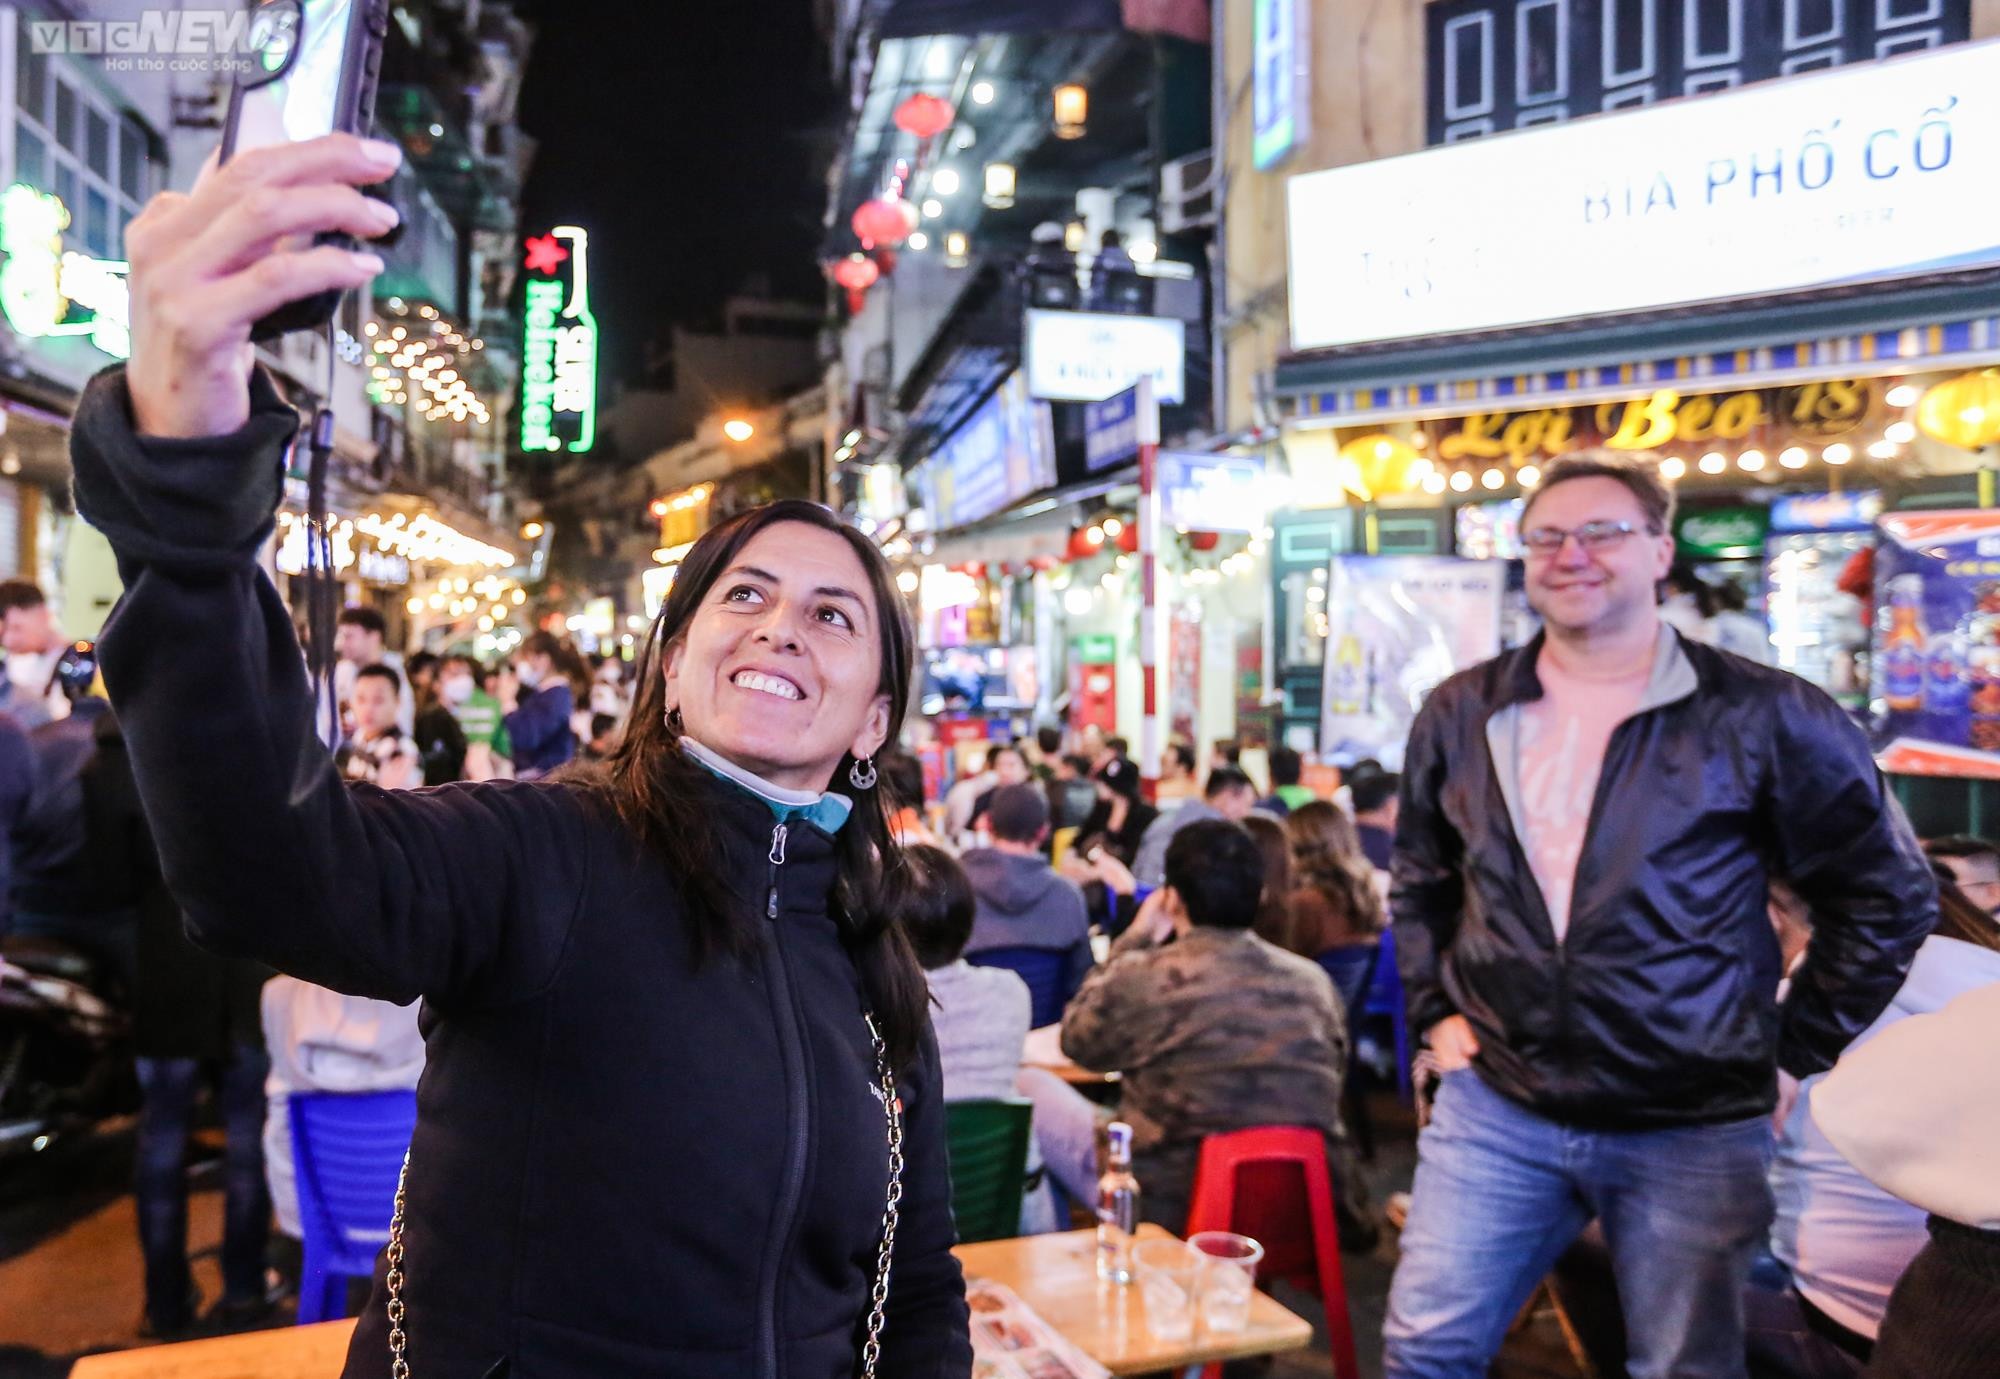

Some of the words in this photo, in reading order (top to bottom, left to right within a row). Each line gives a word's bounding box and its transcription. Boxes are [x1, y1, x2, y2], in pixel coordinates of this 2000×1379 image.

[1584, 171, 1677, 223] BIA
[1706, 118, 1842, 205] PHỐ
[1864, 95, 1958, 181] CỔ
[522, 279, 563, 452] Heineken
